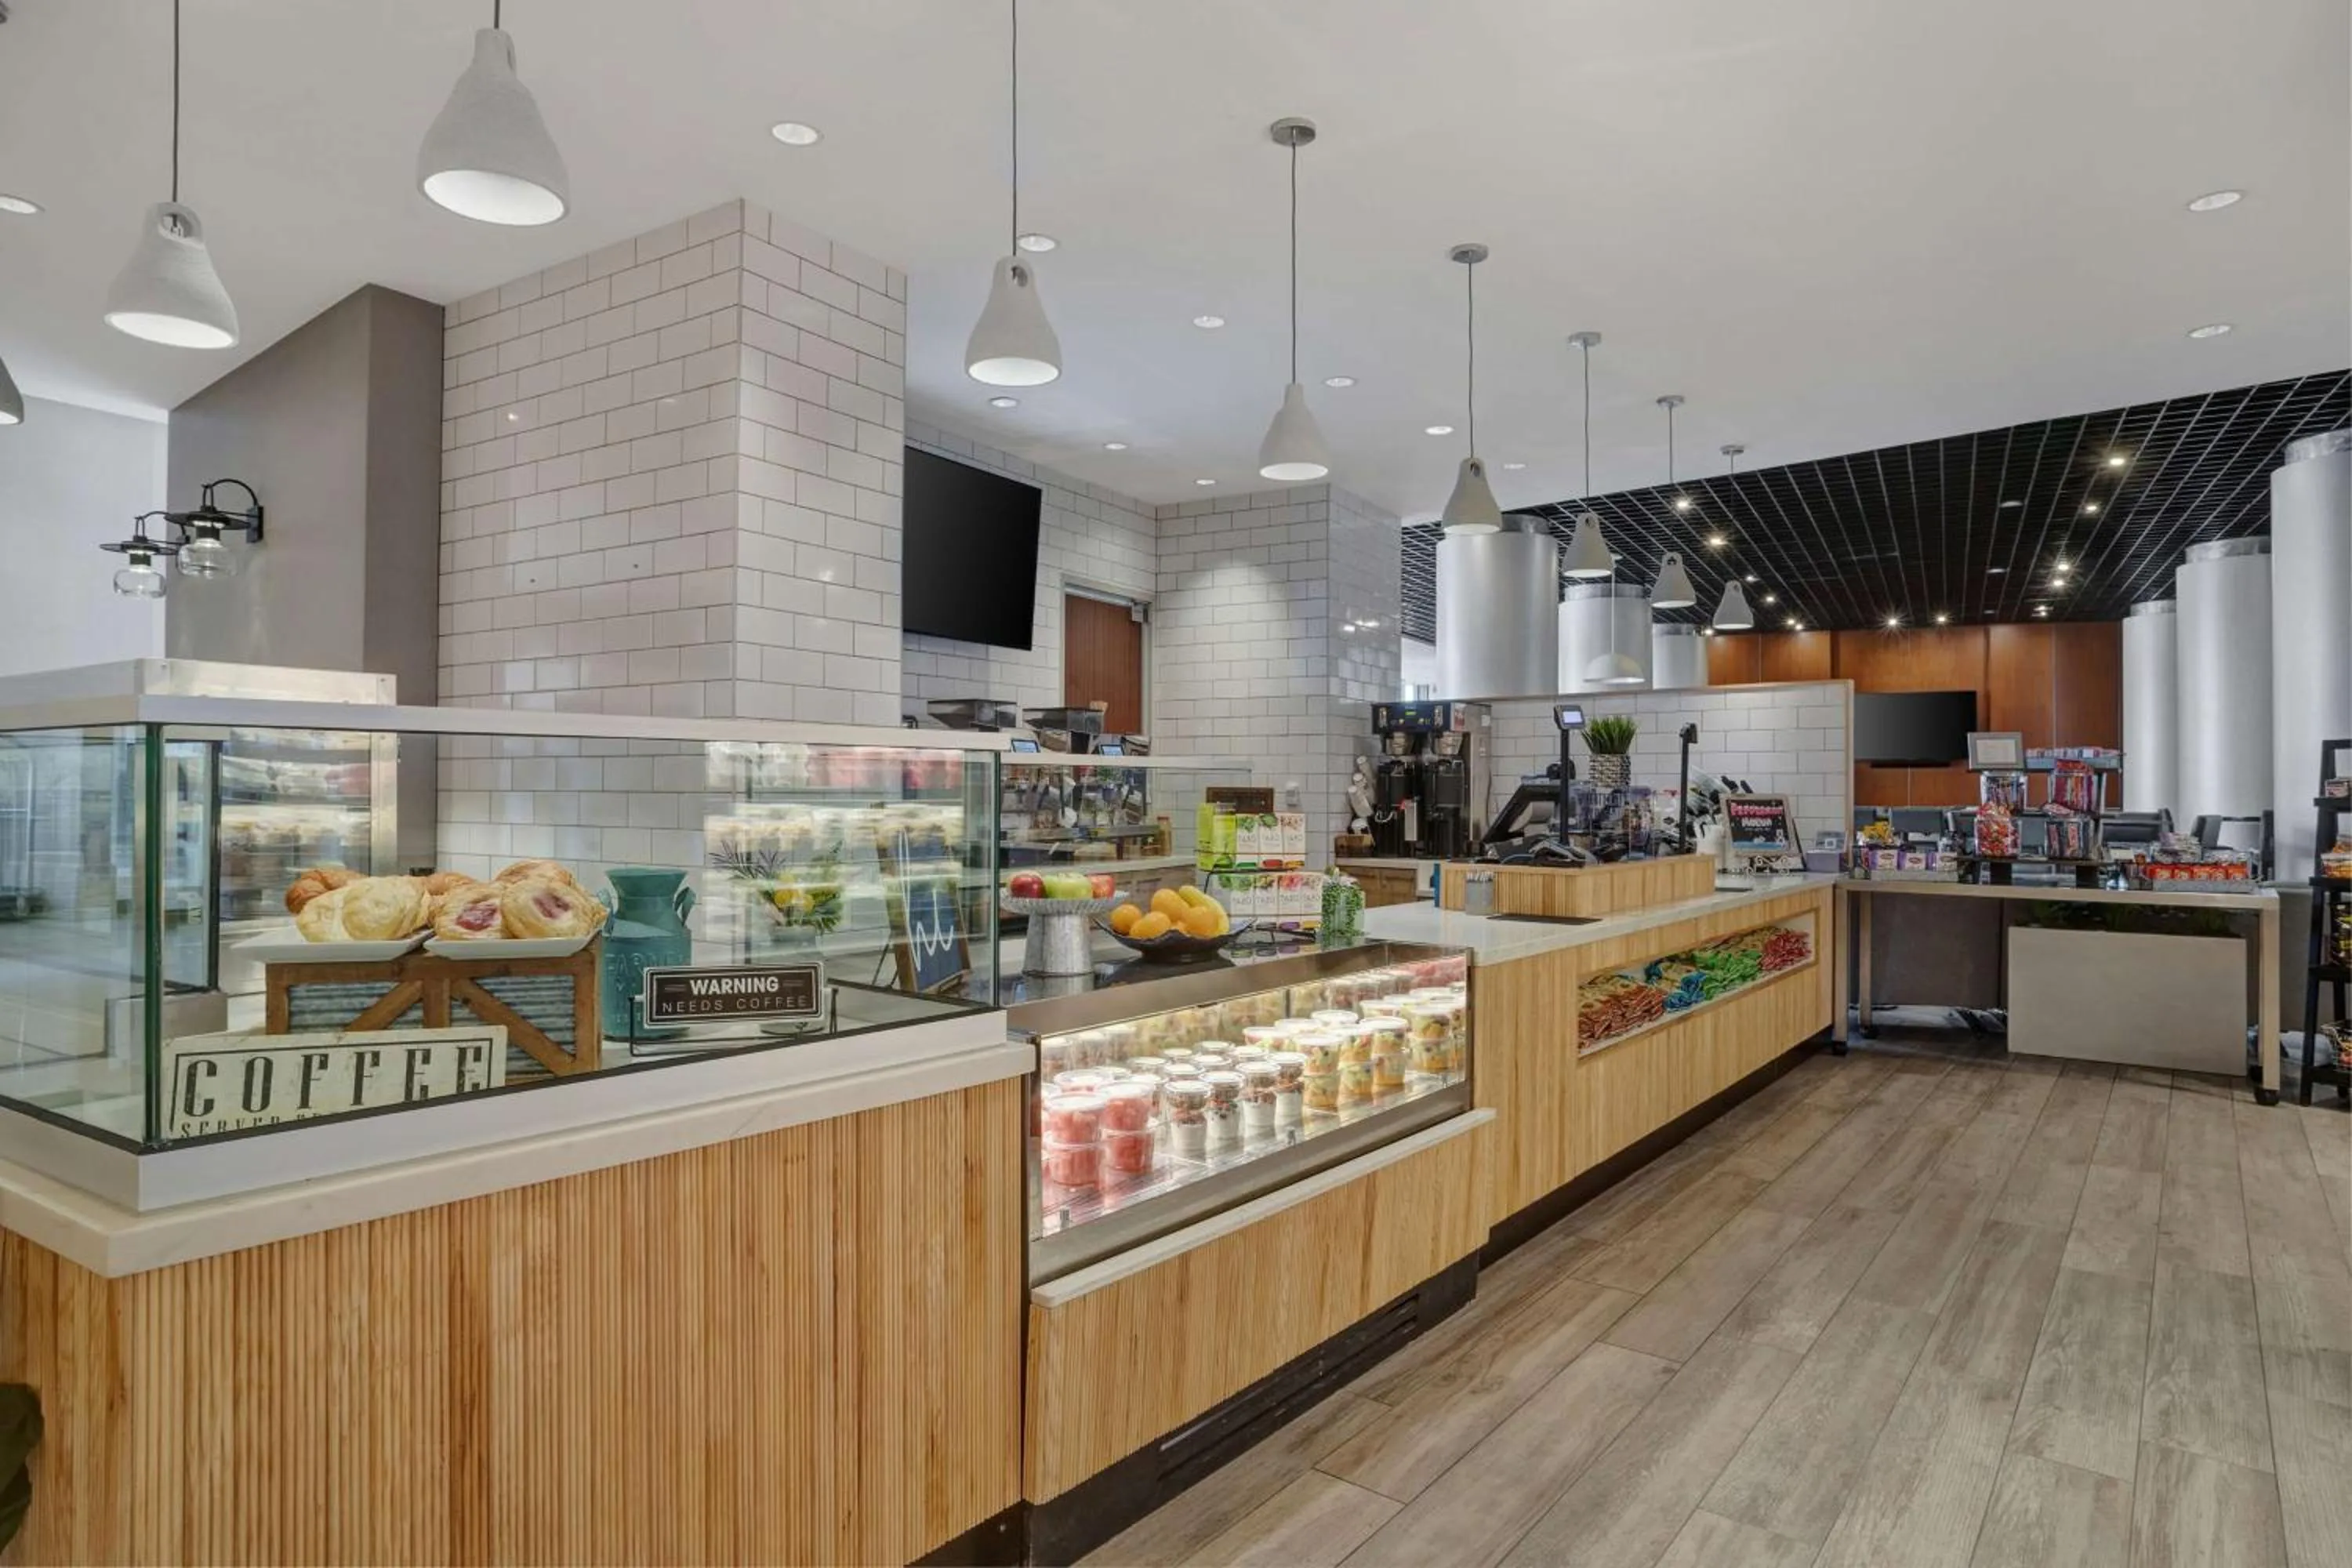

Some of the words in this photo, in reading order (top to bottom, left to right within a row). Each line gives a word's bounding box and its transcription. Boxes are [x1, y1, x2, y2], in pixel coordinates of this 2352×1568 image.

[689, 976, 779, 996] WARNING
[662, 998, 724, 1014] NEEDS
[736, 995, 808, 1011] COFFEE
[183, 1046, 483, 1117] COFFEE
